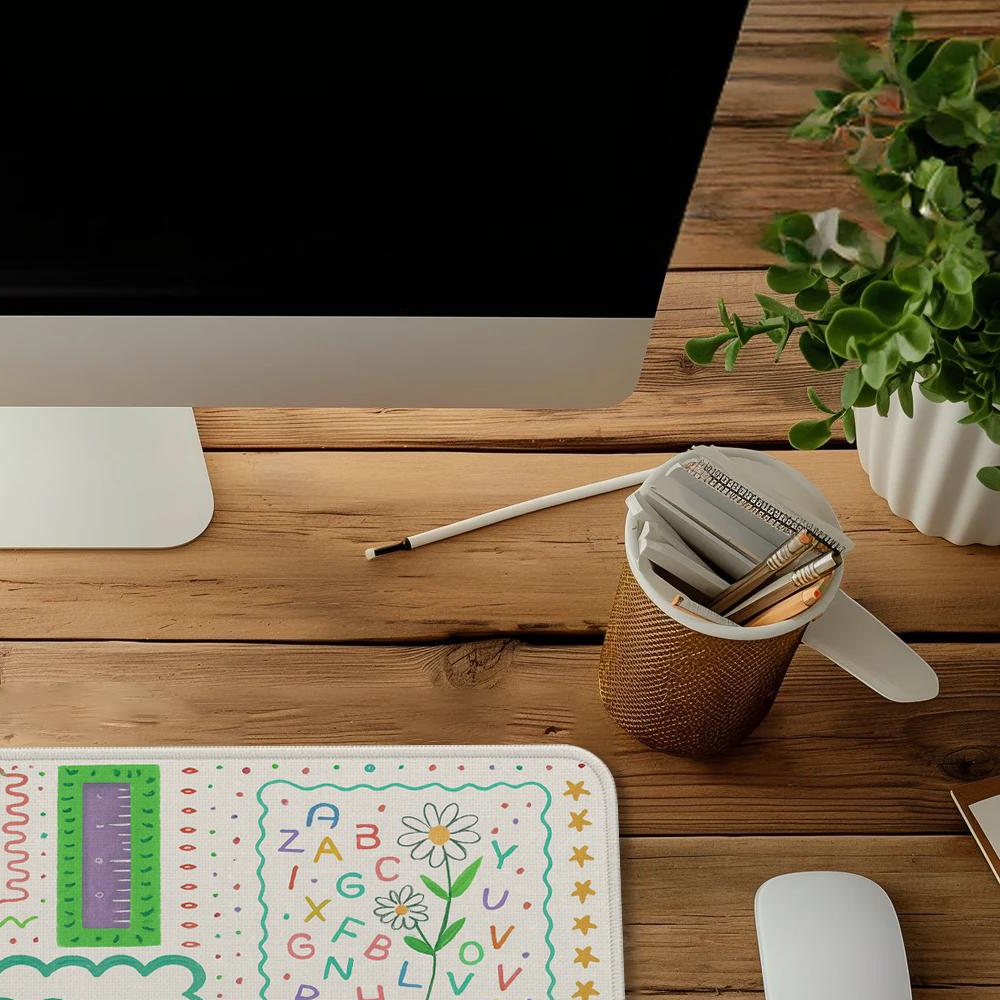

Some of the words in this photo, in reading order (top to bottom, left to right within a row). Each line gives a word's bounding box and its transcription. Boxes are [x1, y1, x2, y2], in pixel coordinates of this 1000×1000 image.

[306, 802, 340, 829] A
[277, 829, 305, 853] Z
[313, 836, 343, 863] A
[355, 823, 381, 850] B
[491, 840, 519, 870] Y
[375, 856, 401, 882] C
[335, 872, 366, 899] G
[482, 887, 510, 910] U
[303, 896, 332, 923] X
[331, 916, 366, 943] F
[490, 925, 516, 950] V
[286, 932, 316, 960] G
[364, 934, 392, 961] B
[458, 940, 485, 966] O
[323, 956, 355, 981] N
[398, 961, 423, 989] L
[498, 964, 523, 992] V
[446, 971, 475, 996] V
